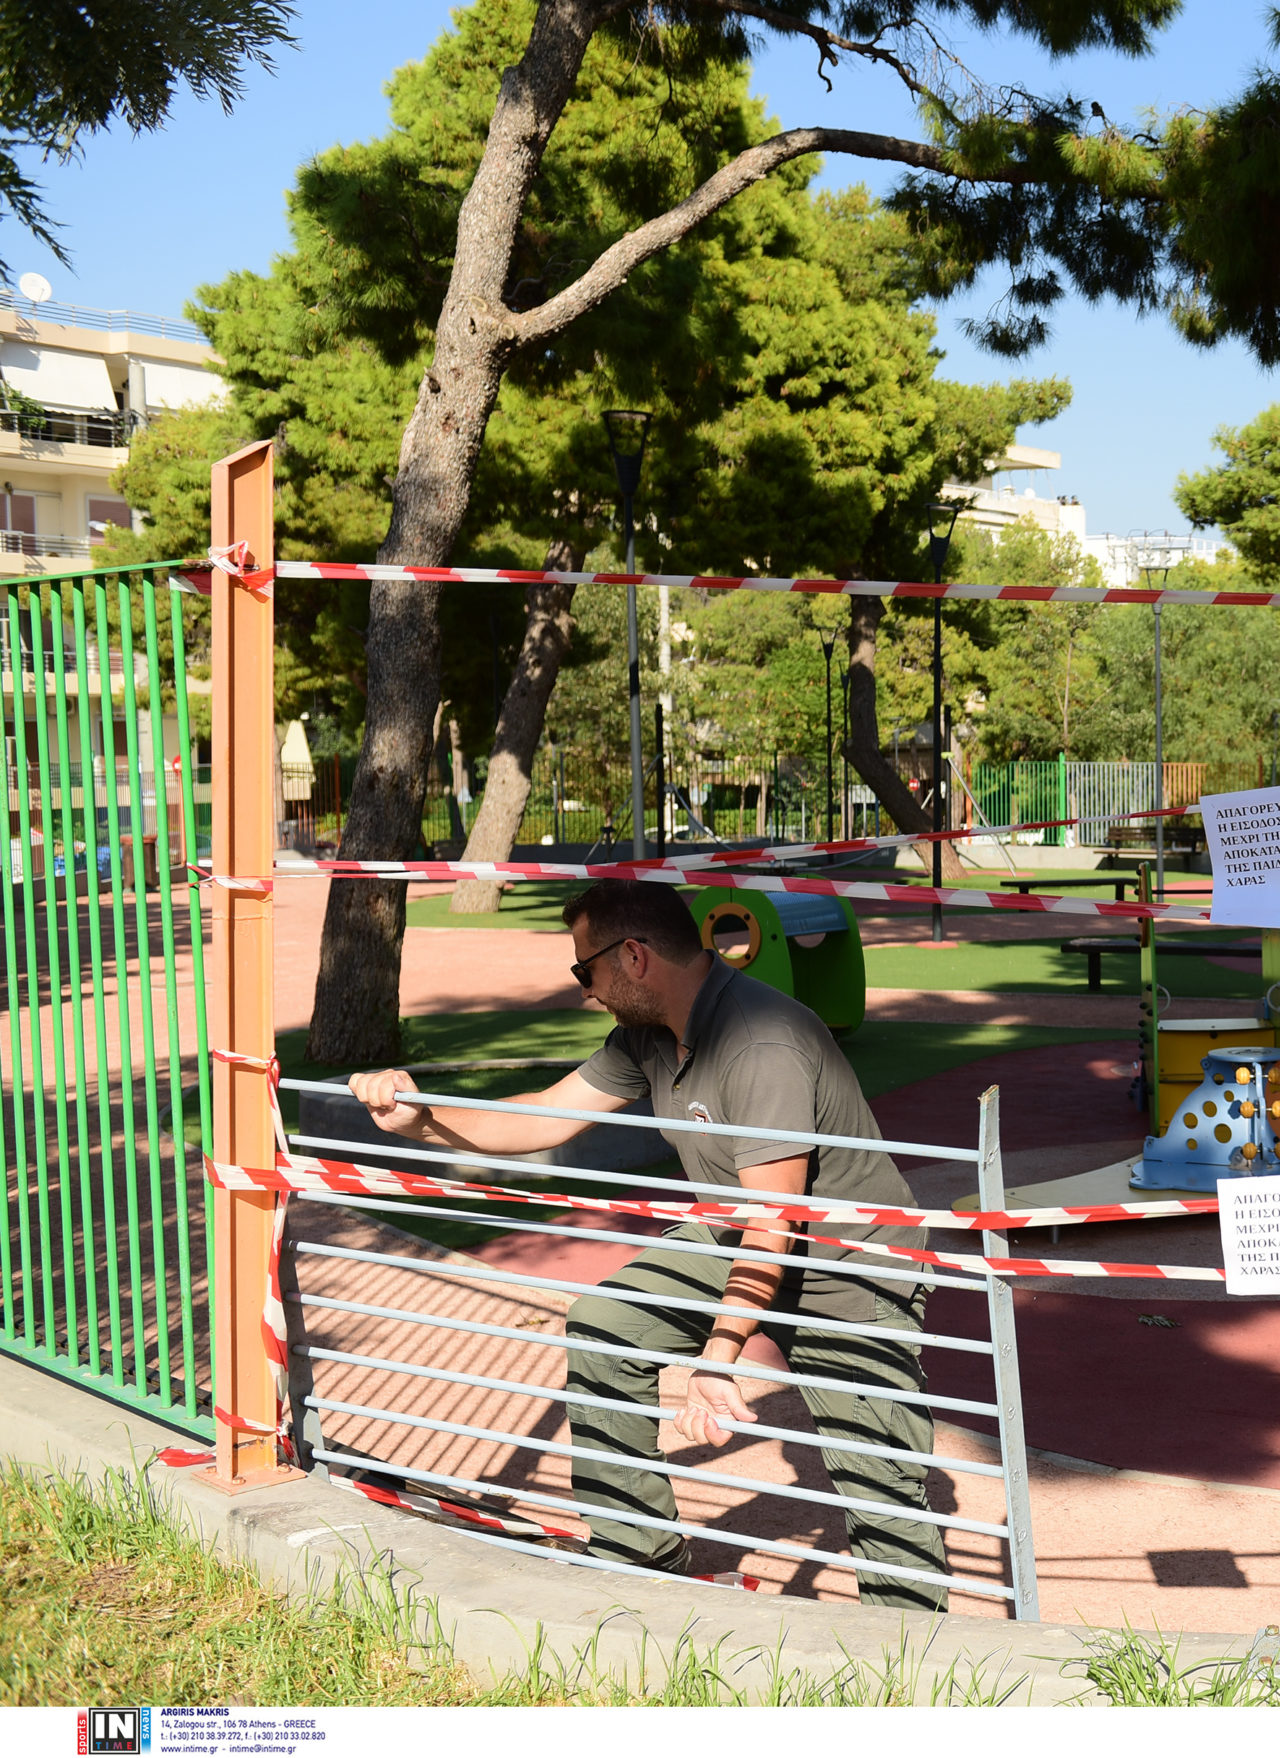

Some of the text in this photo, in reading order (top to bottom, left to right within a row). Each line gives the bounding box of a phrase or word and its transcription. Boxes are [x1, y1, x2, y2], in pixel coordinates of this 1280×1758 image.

[1217, 823, 1227, 833] Η
[1220, 834, 1260, 847] ΜΕΧΡΙ
[1224, 862, 1251, 874] ΤΗΣ
[1226, 875, 1266, 888] ΧΑΡΑΣ
[1235, 1210, 1244, 1219] Η
[1235, 1223, 1280, 1235] ΜΕΧΡΙ
[1237, 1252, 1266, 1262] ΤΗΣ
